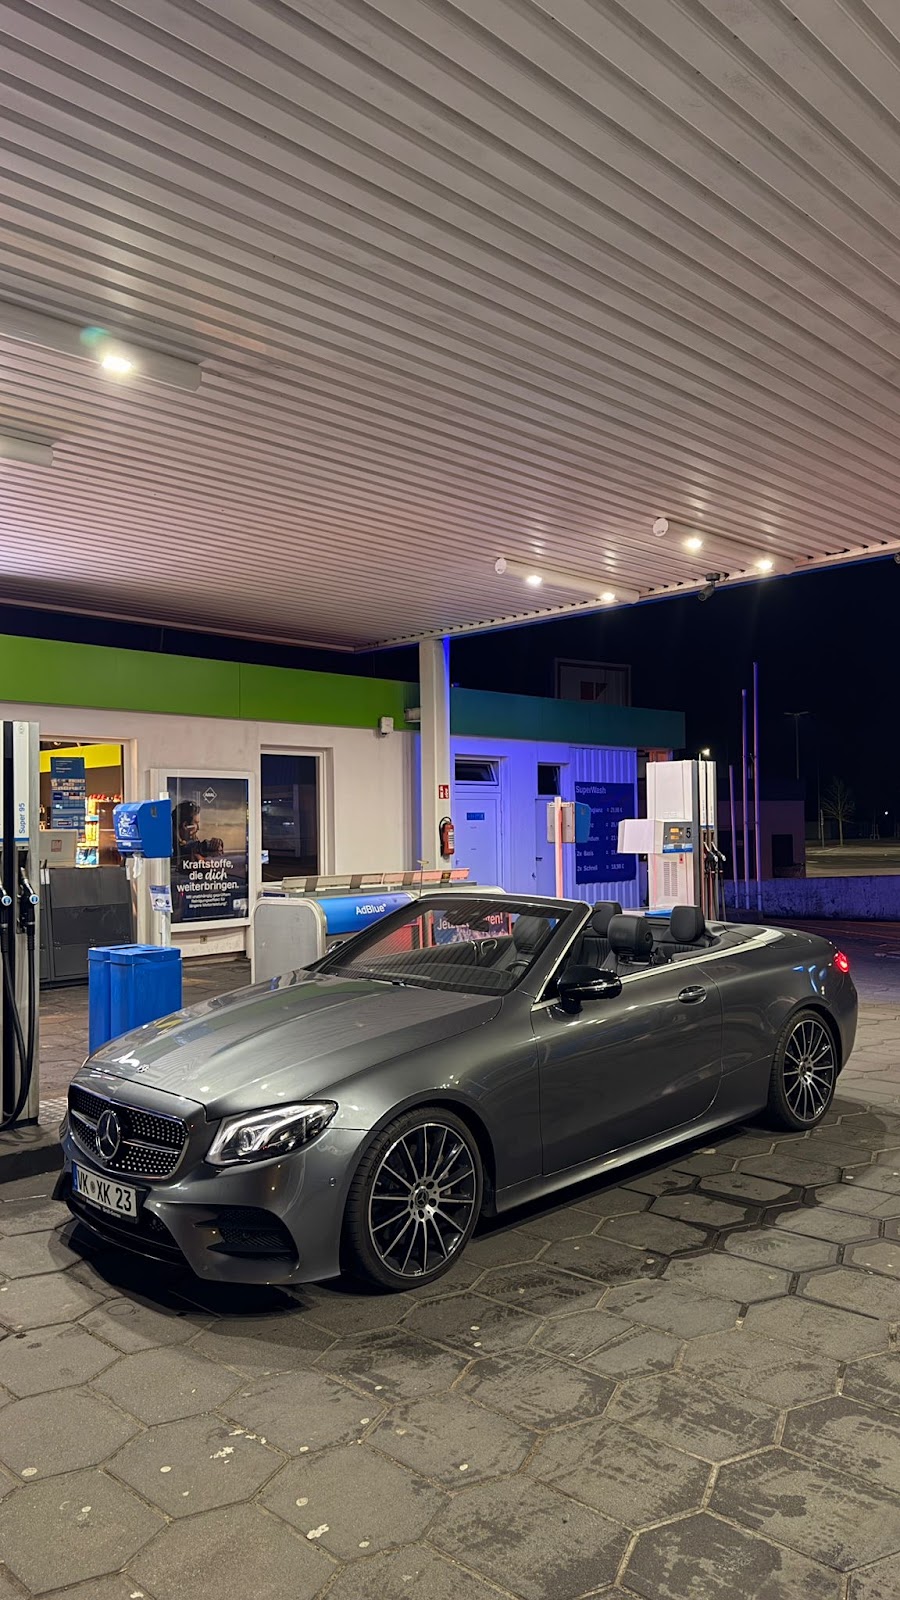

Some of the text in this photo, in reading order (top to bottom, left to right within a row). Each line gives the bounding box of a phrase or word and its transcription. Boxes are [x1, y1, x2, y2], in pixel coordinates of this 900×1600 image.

[575, 785, 606, 795] SuperWash
[19, 803, 25, 812] 95
[686, 827, 691, 838] 5
[182, 859, 234, 870] Kraftstoffe,
[189, 868, 228, 881] die dich
[176, 881, 239, 892] weiterbringen.
[96, 1180, 111, 1206] XK
[115, 1187, 131, 1212] 23
